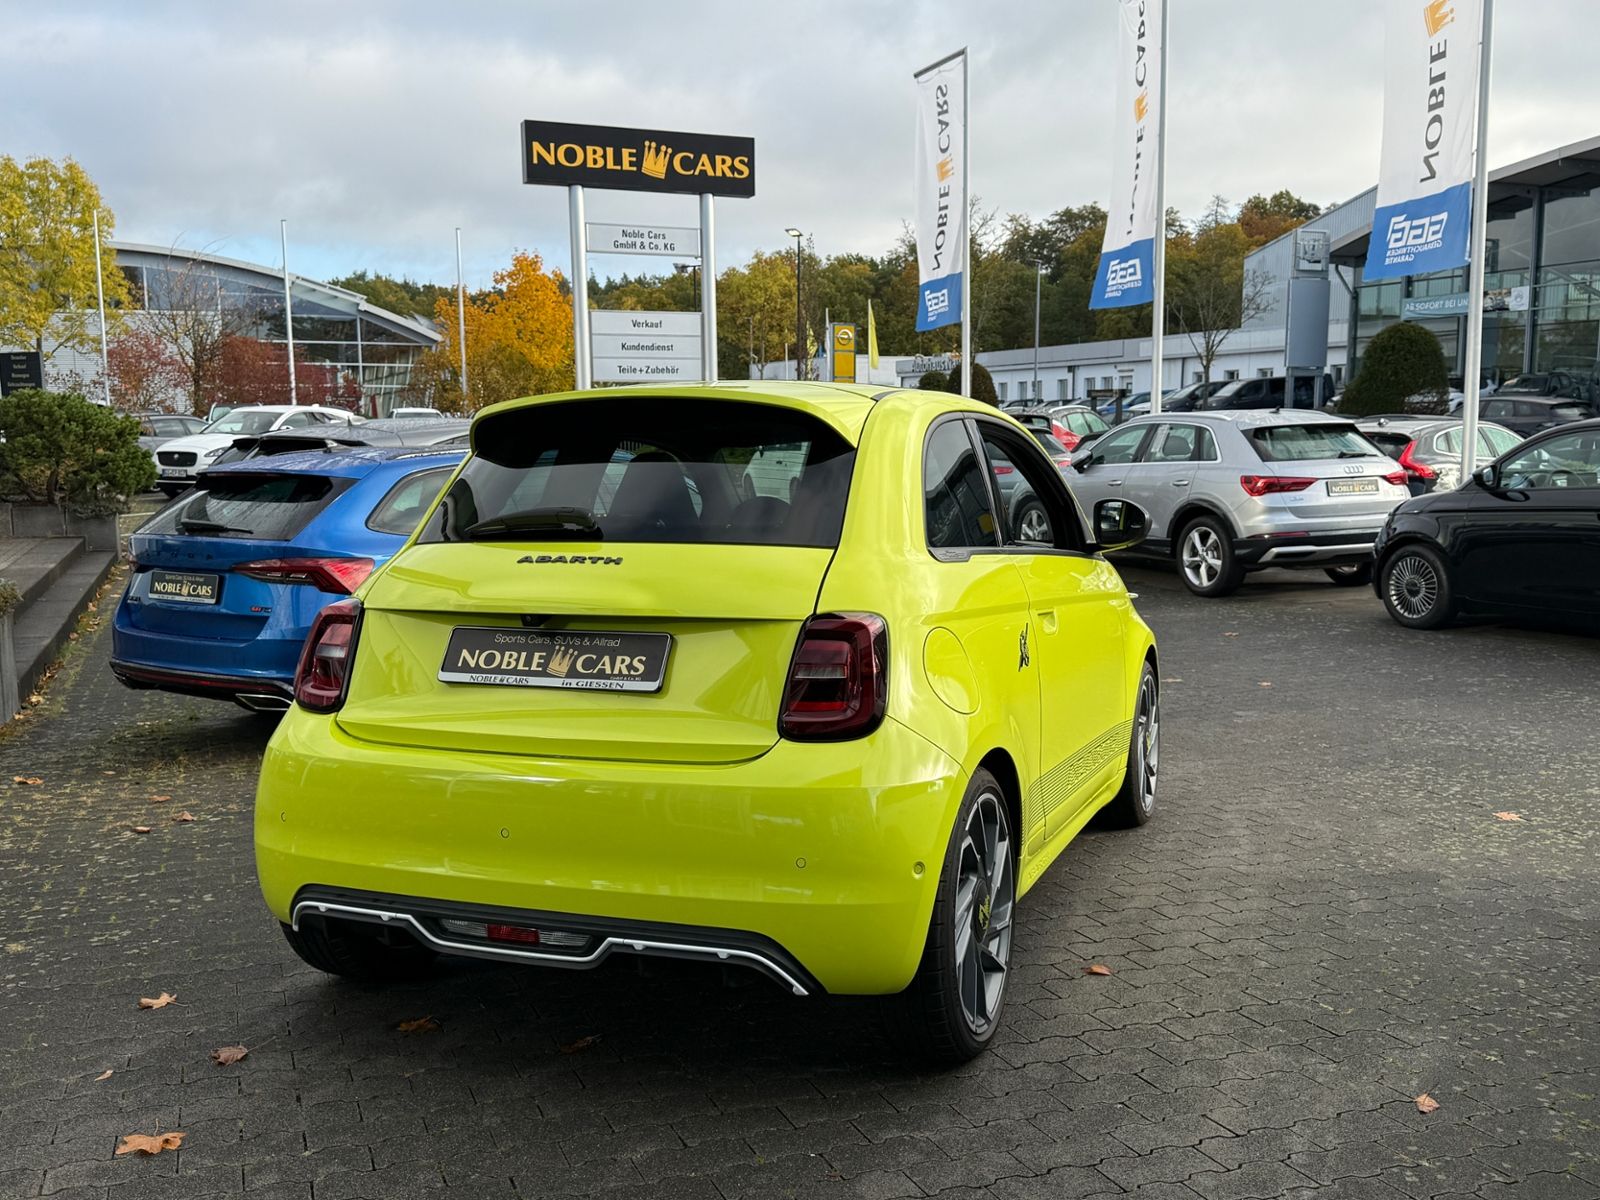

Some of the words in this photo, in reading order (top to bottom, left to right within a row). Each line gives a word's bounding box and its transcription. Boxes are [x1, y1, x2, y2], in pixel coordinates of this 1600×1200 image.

[531, 141, 637, 171] NOBLE
[672, 152, 750, 179] CARS
[622, 229, 645, 239] Noble
[647, 230, 667, 240] Cars
[613, 240, 637, 249] GmbH
[639, 241, 646, 250] &
[648, 242, 662, 251] Co.
[663, 243, 675, 251] KG
[1415, 300, 1444, 311] SOFORT
[1444, 299, 1456, 308] BEI
[1457, 298, 1469, 307] UN
[631, 319, 662, 328] Verkauf
[621, 342, 674, 351] Kundendienst
[516, 555, 623, 565] ABARTH
[153, 581, 181, 593] NOBLE
[190, 584, 212, 596] CARS
[494, 633, 526, 645] Sports
[527, 634, 552, 645] Cars,
[553, 635, 581, 646] SUVs
[582, 637, 591, 646] &
[592, 637, 621, 647] Allrad
[457, 648, 546, 671] NOBLE
[575, 654, 647, 676] CARS
[468, 674, 499, 683] NOBLE
[575, 680, 625, 689] GIESSEN
